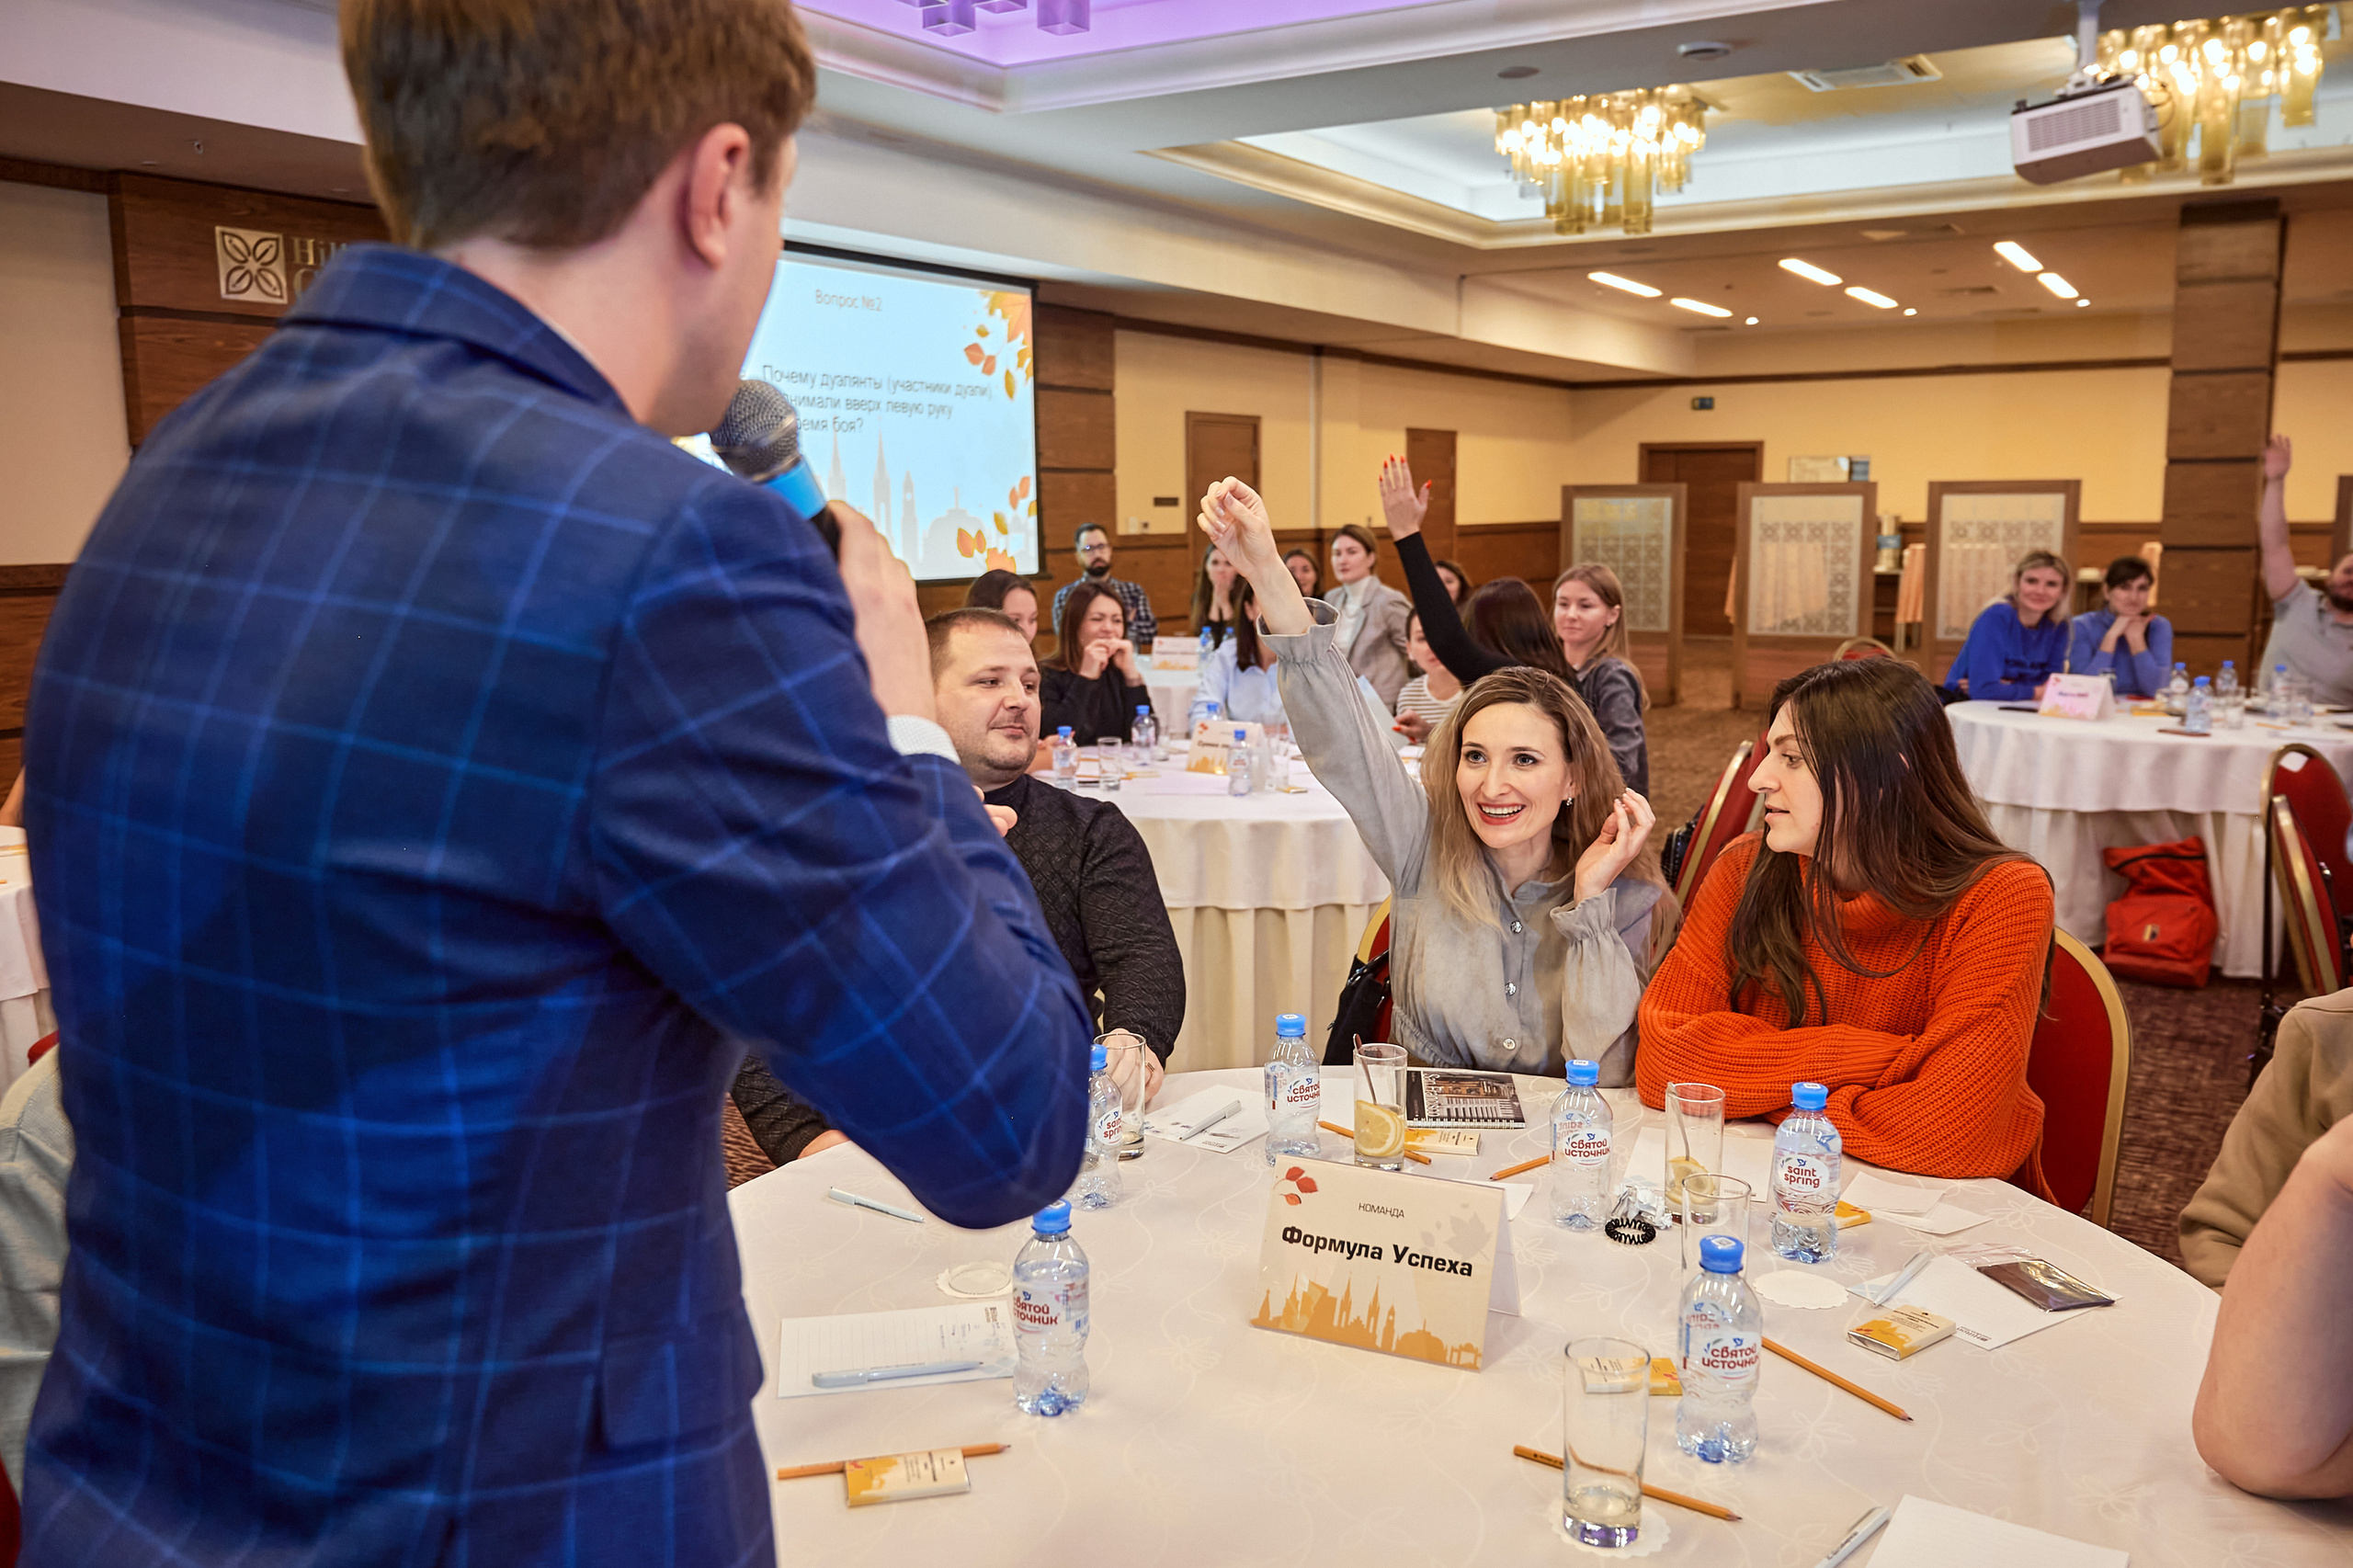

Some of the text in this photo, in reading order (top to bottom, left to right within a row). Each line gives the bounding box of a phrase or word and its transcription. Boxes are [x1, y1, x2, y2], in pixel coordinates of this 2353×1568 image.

[815, 289, 882, 312] Вопрос №2
[763, 364, 816, 389] Почему
[821, 373, 882, 391] дуэлянты
[887, 375, 951, 395] (участники
[846, 398, 881, 414] вверх
[885, 401, 925, 417] левую
[927, 403, 953, 419] руку
[833, 416, 863, 433] боя?
[1784, 1173, 1820, 1188] spring
[1787, 1165, 1817, 1177] saint
[1358, 1202, 1404, 1219] КОМАНДА
[1281, 1225, 1473, 1278] Формула Успеха
